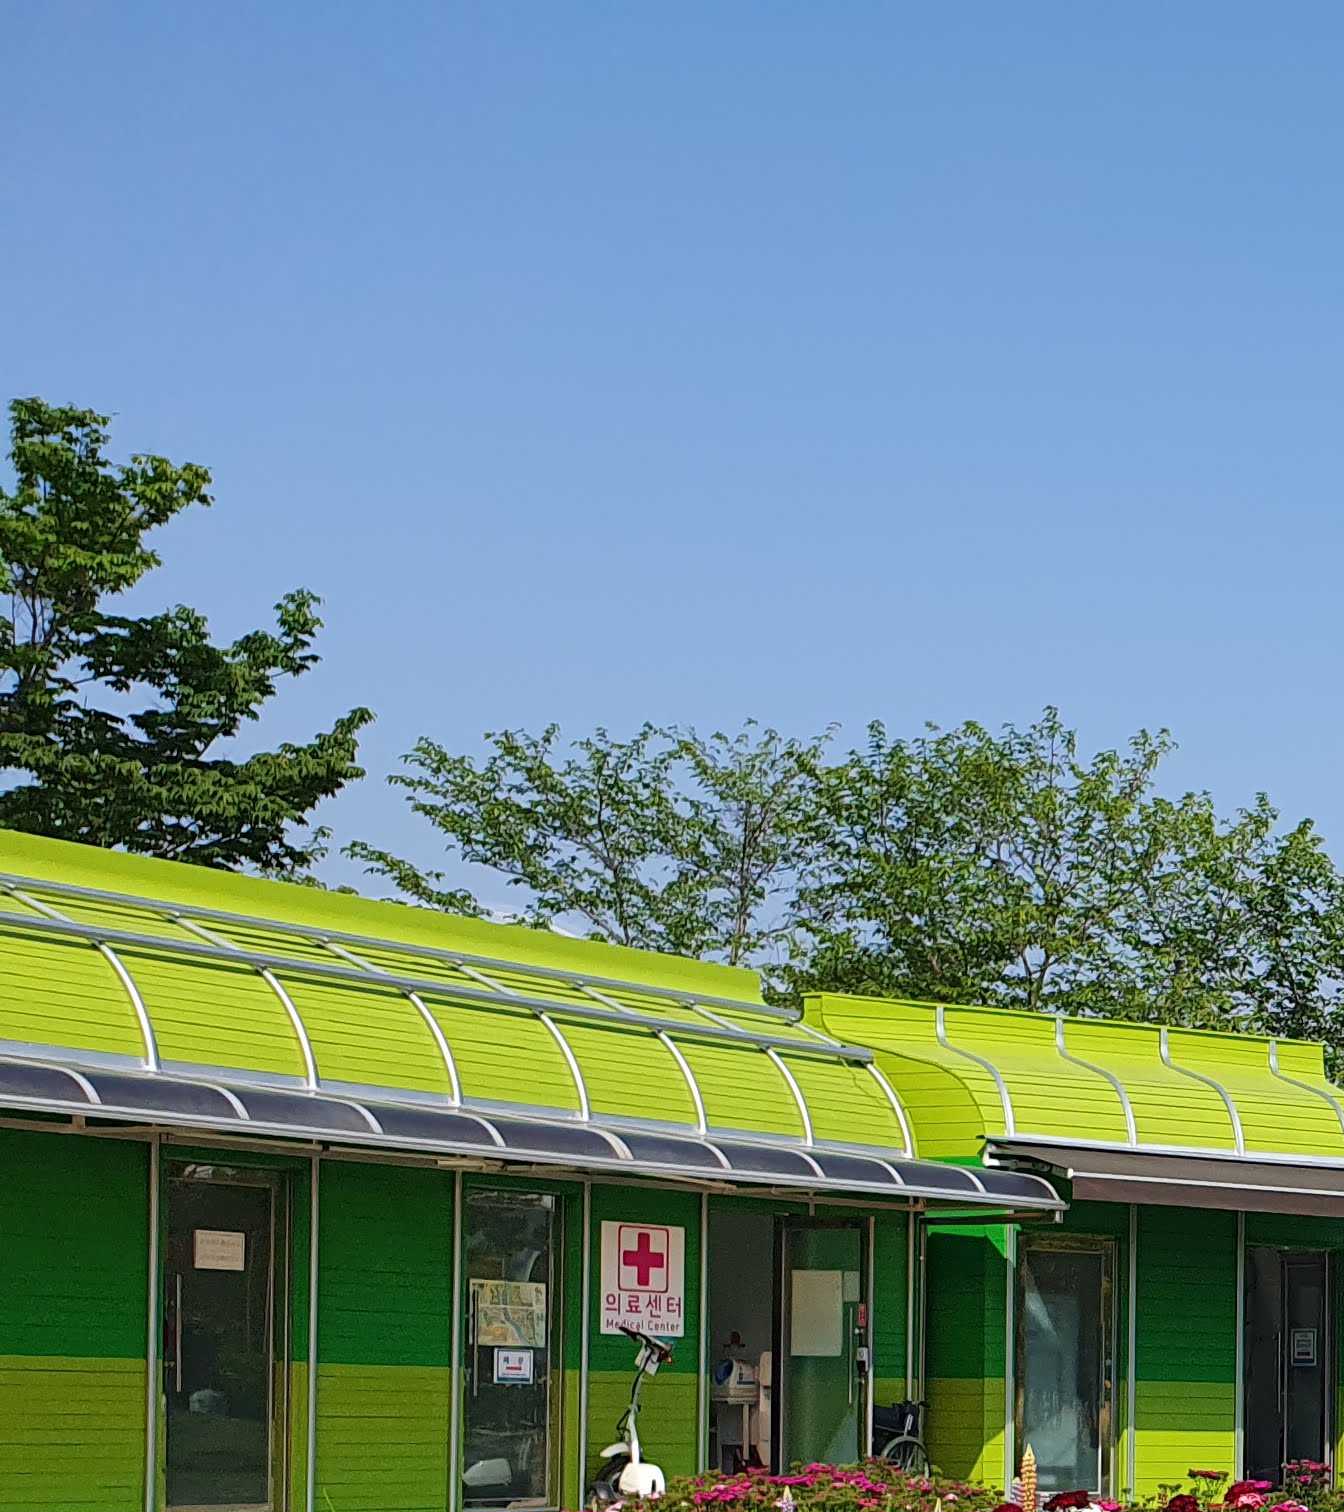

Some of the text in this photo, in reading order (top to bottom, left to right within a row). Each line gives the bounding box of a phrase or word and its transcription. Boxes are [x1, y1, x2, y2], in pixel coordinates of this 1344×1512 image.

[606, 1293, 681, 1318] 의료센터
[606, 1318, 680, 1332] Medical Center
